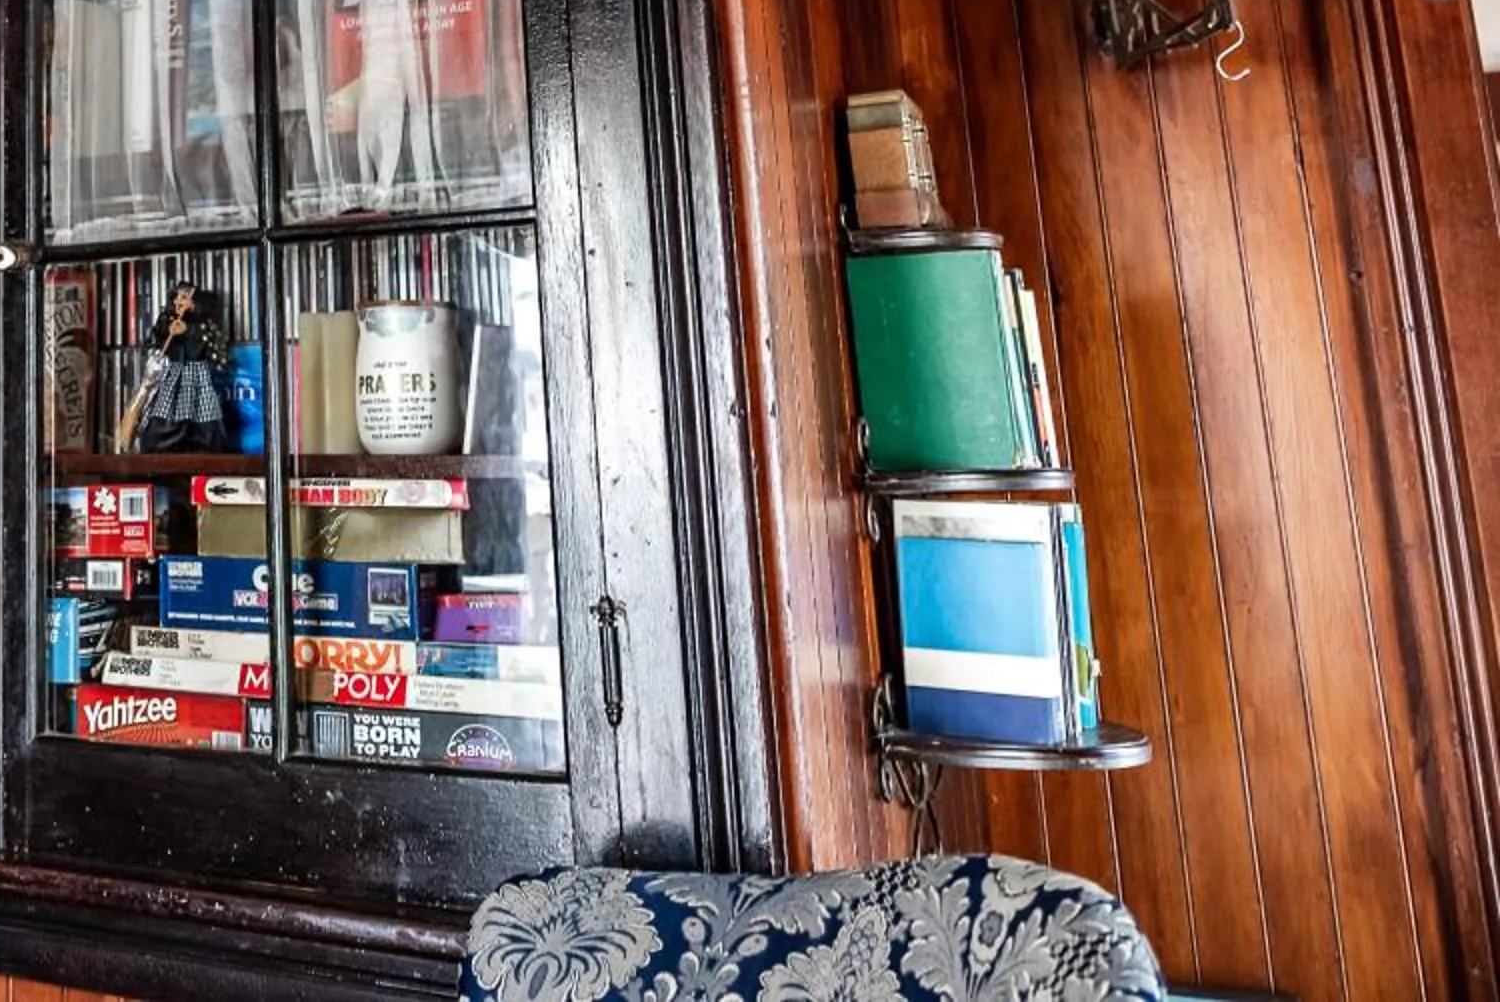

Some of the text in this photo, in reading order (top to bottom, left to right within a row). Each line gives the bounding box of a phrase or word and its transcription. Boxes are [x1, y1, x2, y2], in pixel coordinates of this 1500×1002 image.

[358, 371, 436, 395] PRAERS
[293, 639, 402, 673] ORRY!
[84, 695, 177, 734] Yahtzee
[354, 714, 421, 728] YOU WERE
[353, 725, 421, 746] BORN
[354, 742, 376, 756] TO
[379, 744, 421, 760] PLAY
